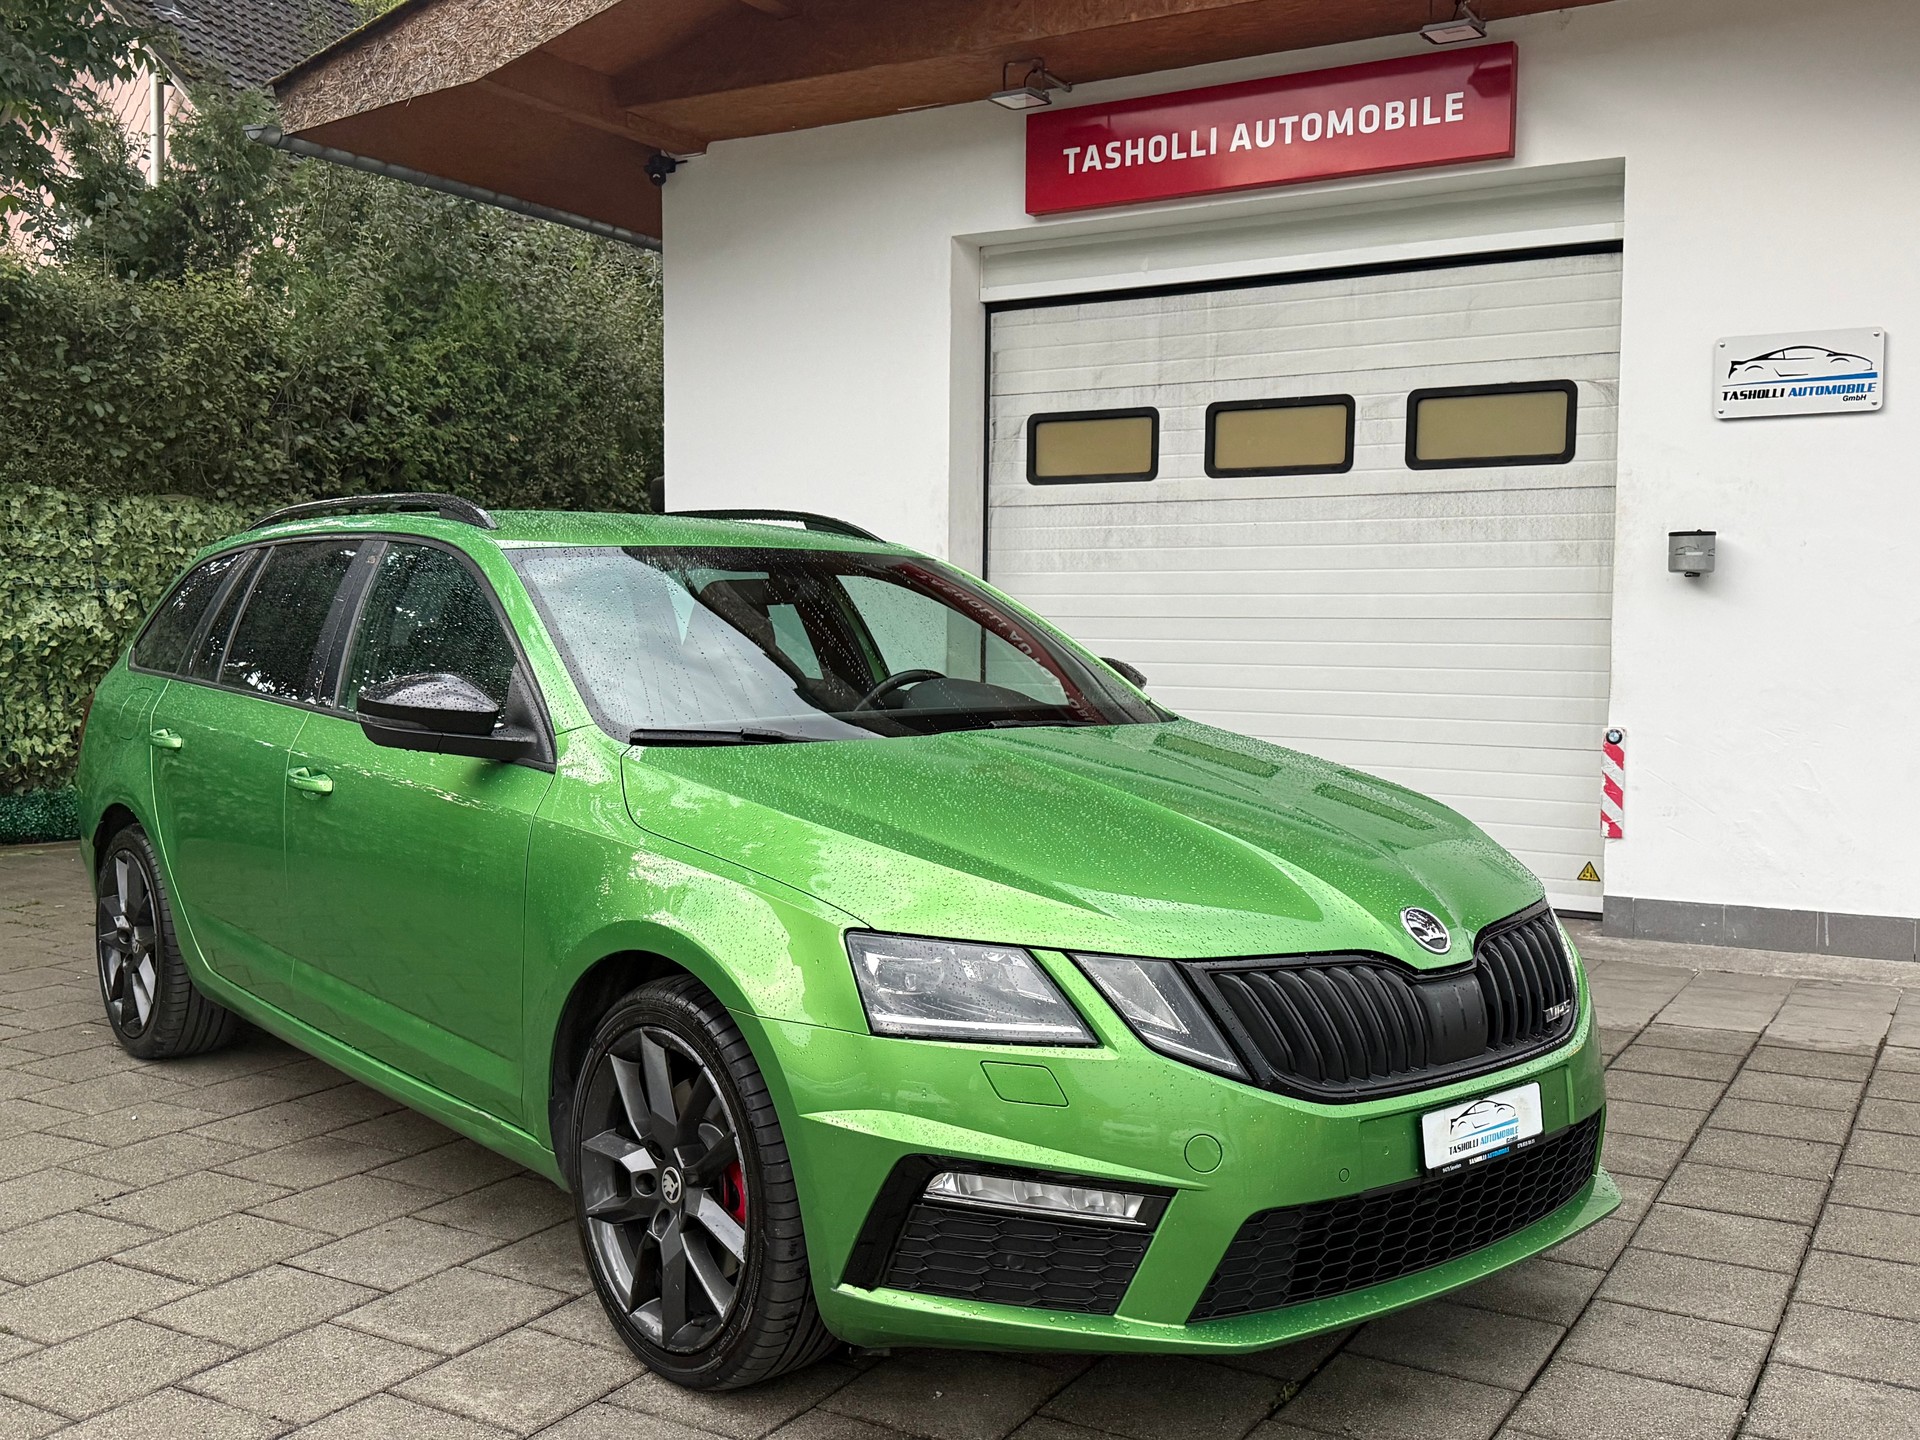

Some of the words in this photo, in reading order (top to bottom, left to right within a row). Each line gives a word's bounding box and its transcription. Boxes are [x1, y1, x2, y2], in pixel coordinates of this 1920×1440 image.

[1063, 126, 1217, 174] TASHOLLI
[1229, 91, 1465, 153] AUTOMOBILE
[1722, 387, 1785, 401] TASHOLLI
[1788, 382, 1877, 398] AUTOMOBILE
[1842, 394, 1867, 402] GmbH
[1448, 1138, 1479, 1155] TASHOLLI
[1480, 1125, 1519, 1145] AUTOMOBILE
